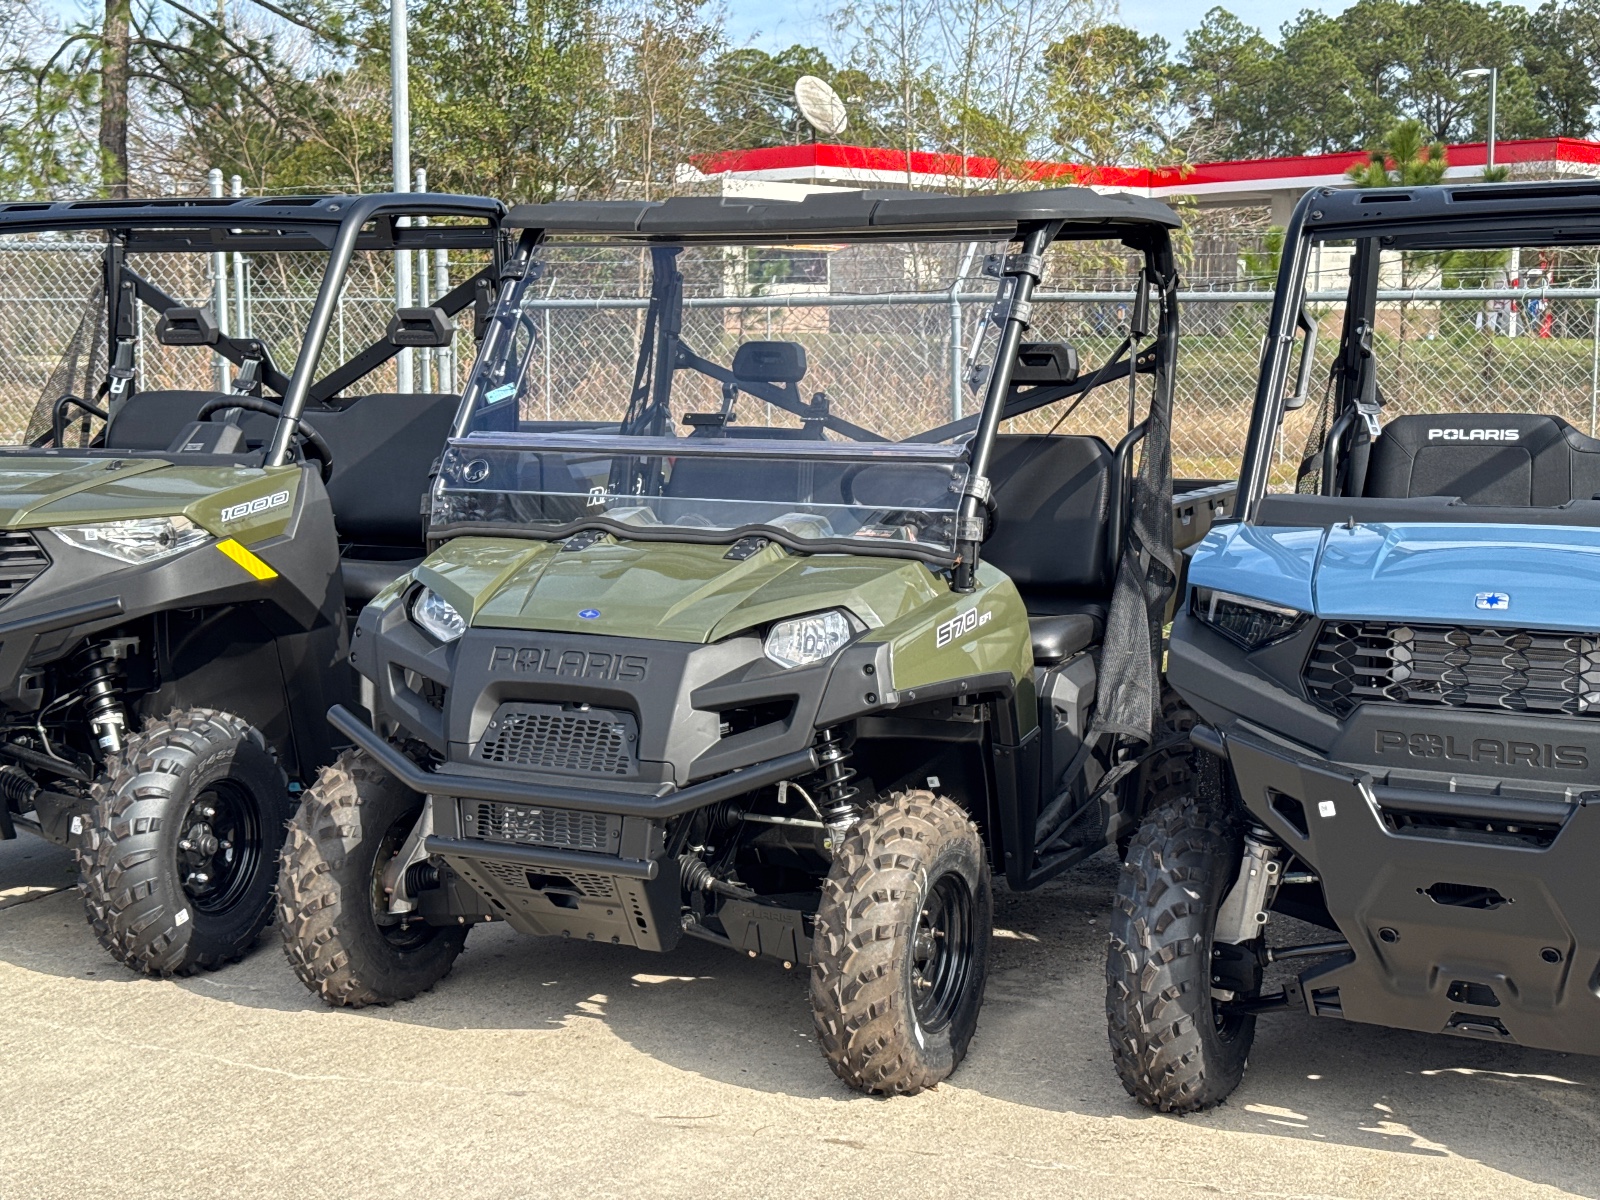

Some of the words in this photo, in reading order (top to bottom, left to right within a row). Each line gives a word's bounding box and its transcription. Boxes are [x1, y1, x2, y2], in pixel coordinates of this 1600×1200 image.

[1428, 429, 1520, 441] POLARIS
[221, 490, 290, 523] 1000
[936, 606, 978, 649] 570
[487, 646, 649, 682] POLARIS
[1374, 729, 1589, 770] POLARIS
